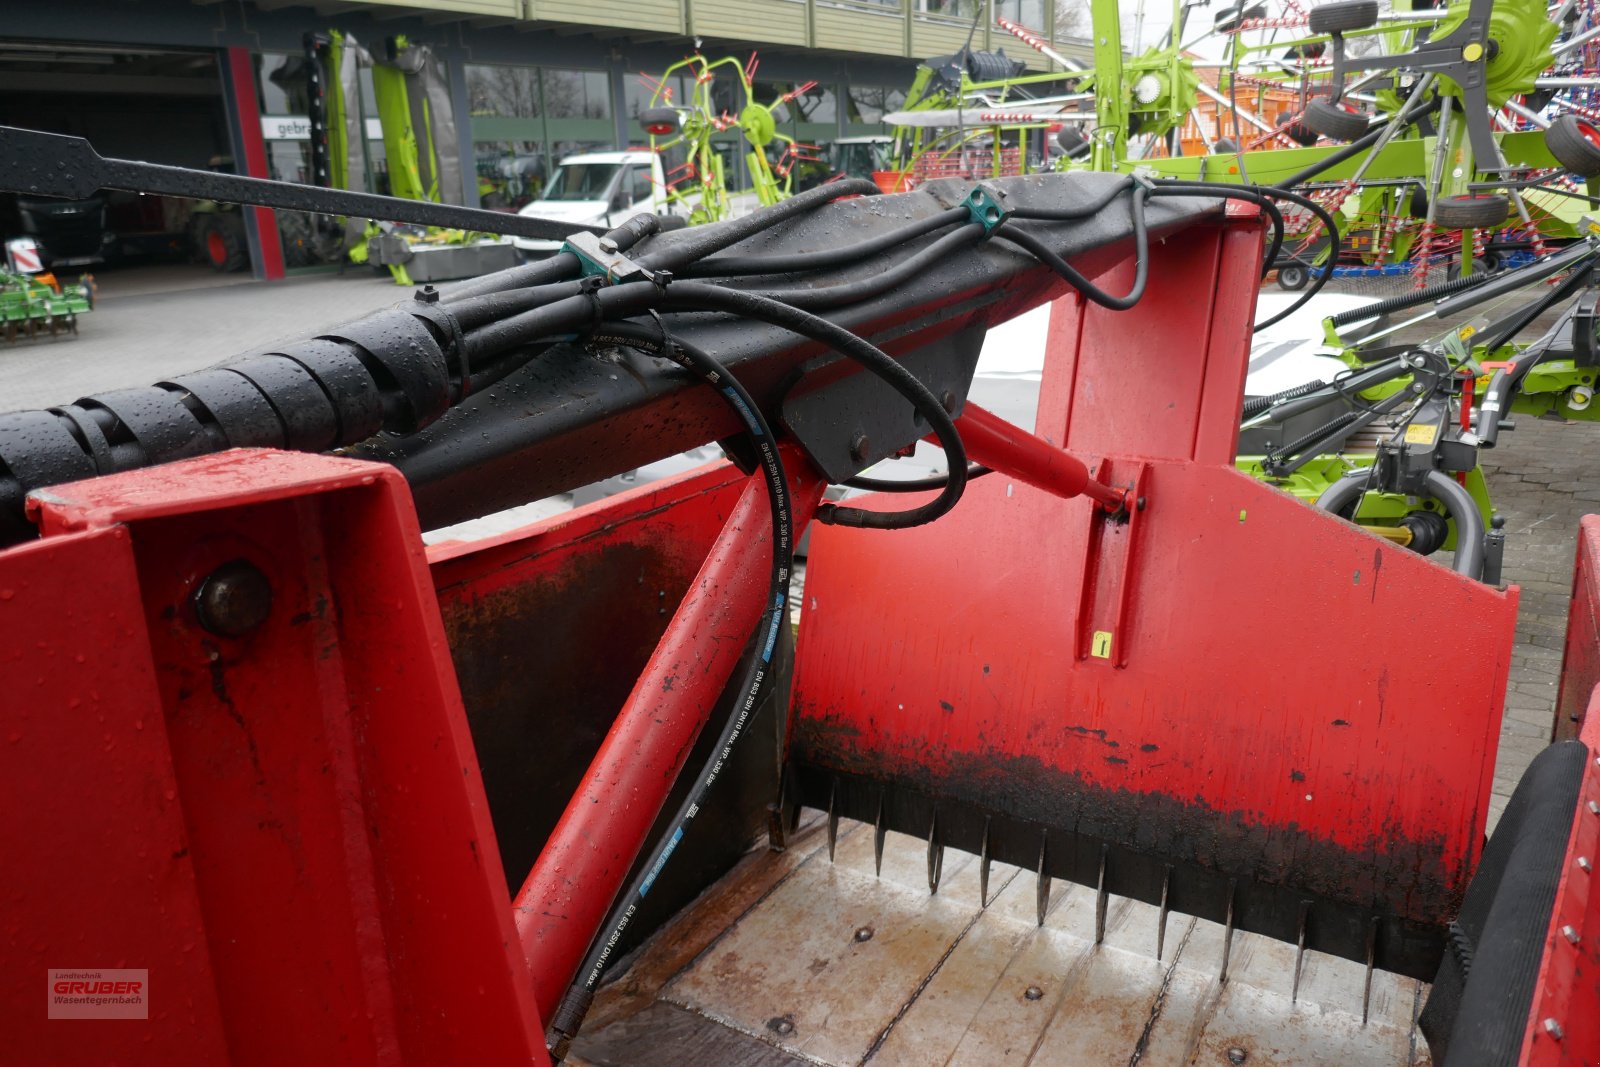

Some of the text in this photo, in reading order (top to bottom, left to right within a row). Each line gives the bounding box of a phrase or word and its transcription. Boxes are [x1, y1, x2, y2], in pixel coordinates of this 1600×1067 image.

[761, 442, 770, 452] EN
[764, 451, 774, 463] 853
[769, 463, 779, 476] 2SN
[773, 476, 783, 494] DN10
[755, 671, 764, 682] EN
[750, 682, 760, 695] 853
[744, 695, 755, 710] 2SN
[735, 710, 749, 730] DN10
[727, 729, 740, 745] Max.
[712, 760, 723, 774] 330
[705, 773, 716, 787] Bar
[585, 904, 636, 987] EN 853 2SN DN10 Max.
